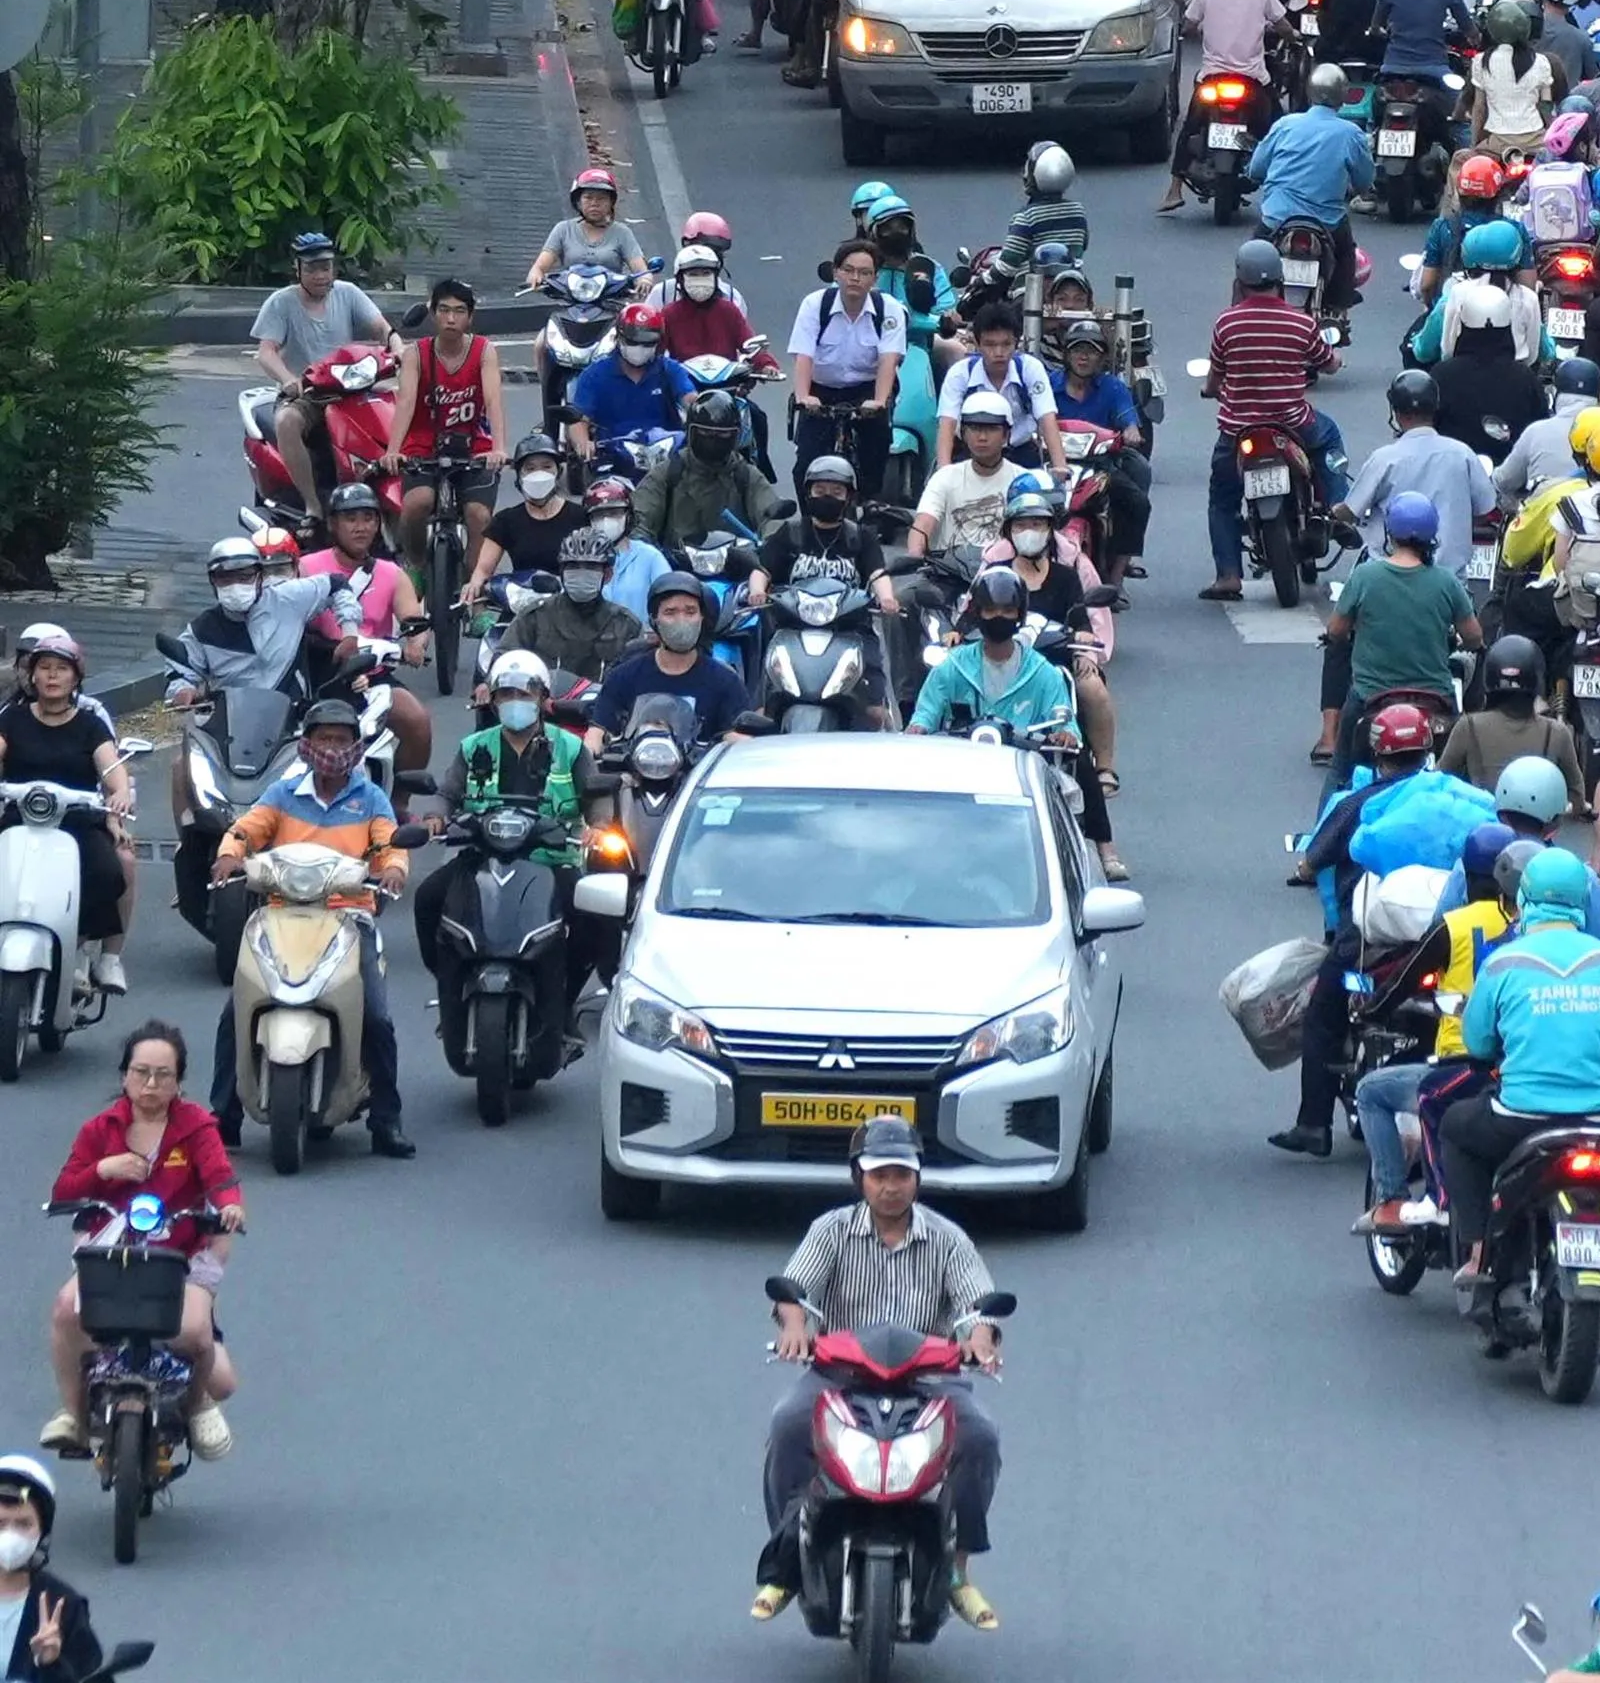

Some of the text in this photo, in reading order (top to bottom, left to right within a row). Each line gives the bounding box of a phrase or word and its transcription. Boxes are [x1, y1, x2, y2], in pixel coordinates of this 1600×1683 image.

[445, 402, 476, 427] 20
[1529, 986, 1579, 1002] XANH
[1532, 1000, 1558, 1016] xin
